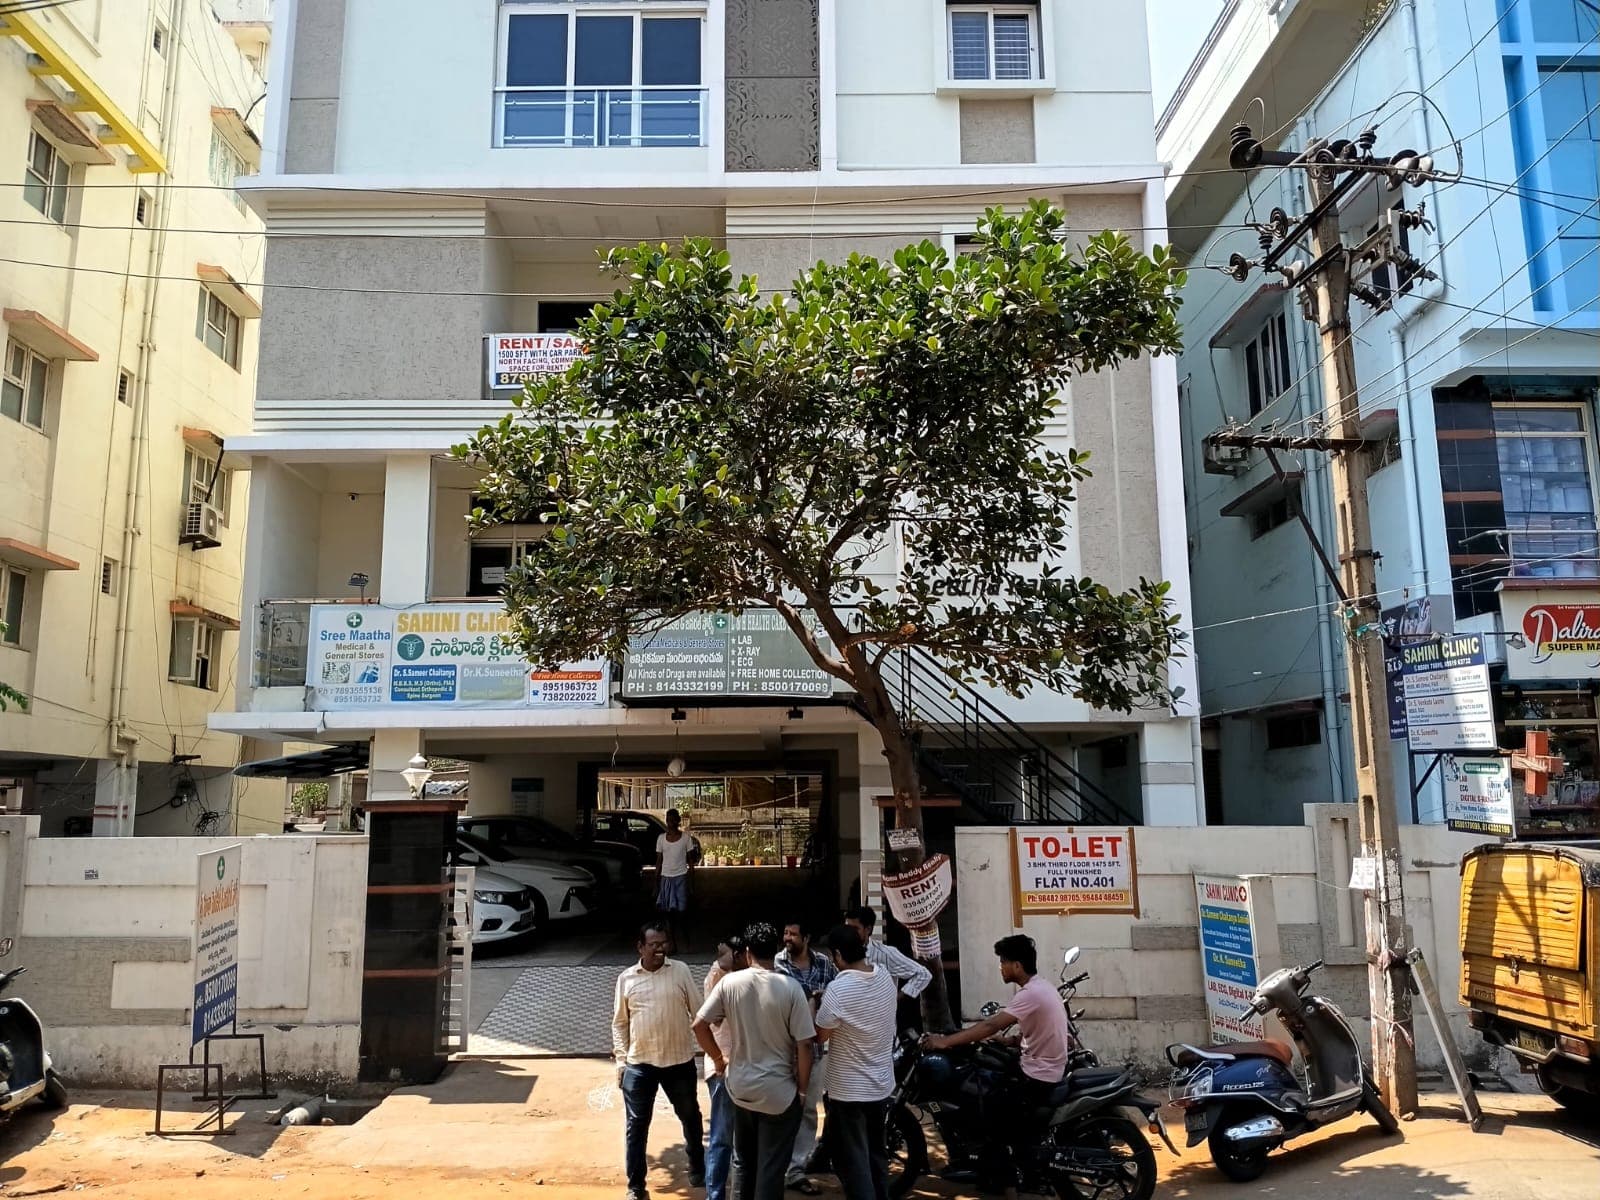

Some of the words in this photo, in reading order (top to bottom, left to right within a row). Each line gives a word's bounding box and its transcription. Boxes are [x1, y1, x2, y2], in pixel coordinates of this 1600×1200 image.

[498, 350, 513, 358] 1500
[516, 350, 527, 358] SFT
[530, 349, 547, 358] WITH
[397, 612, 460, 633] SAHINI
[320, 630, 346, 640] Sree
[350, 630, 391, 640] Maatha
[737, 635, 753, 644] LAB
[1404, 643, 1440, 664] SAHINI
[1442, 637, 1480, 658] CLINIC
[1548, 643, 1583, 651] SUPER
[325, 652, 356, 660] General
[359, 651, 384, 659] Stores
[737, 657, 753, 666] ECG
[394, 669, 402, 677] Dr.
[429, 668, 455, 678] Chaitanya
[628, 669, 637, 679] All
[638, 669, 657, 679] Kinds
[658, 669, 665, 678] of
[666, 668, 685, 681] Drugs
[698, 668, 726, 678] available
[737, 669, 757, 678] FREE
[759, 669, 780, 678] HOME
[782, 669, 827, 679] COLLECTION
[542, 682, 597, 691] 8951963732
[627, 682, 645, 692] PH
[656, 681, 724, 691] 8143332199
[733, 682, 750, 691] PH
[761, 682, 828, 692] 8500170099
[542, 692, 597, 701] 7382022022
[1024, 836, 1122, 858] TO-LET
[900, 874, 937, 899] RENT
[1035, 877, 1066, 888] FLAT
[1071, 876, 1114, 888] NO.401
